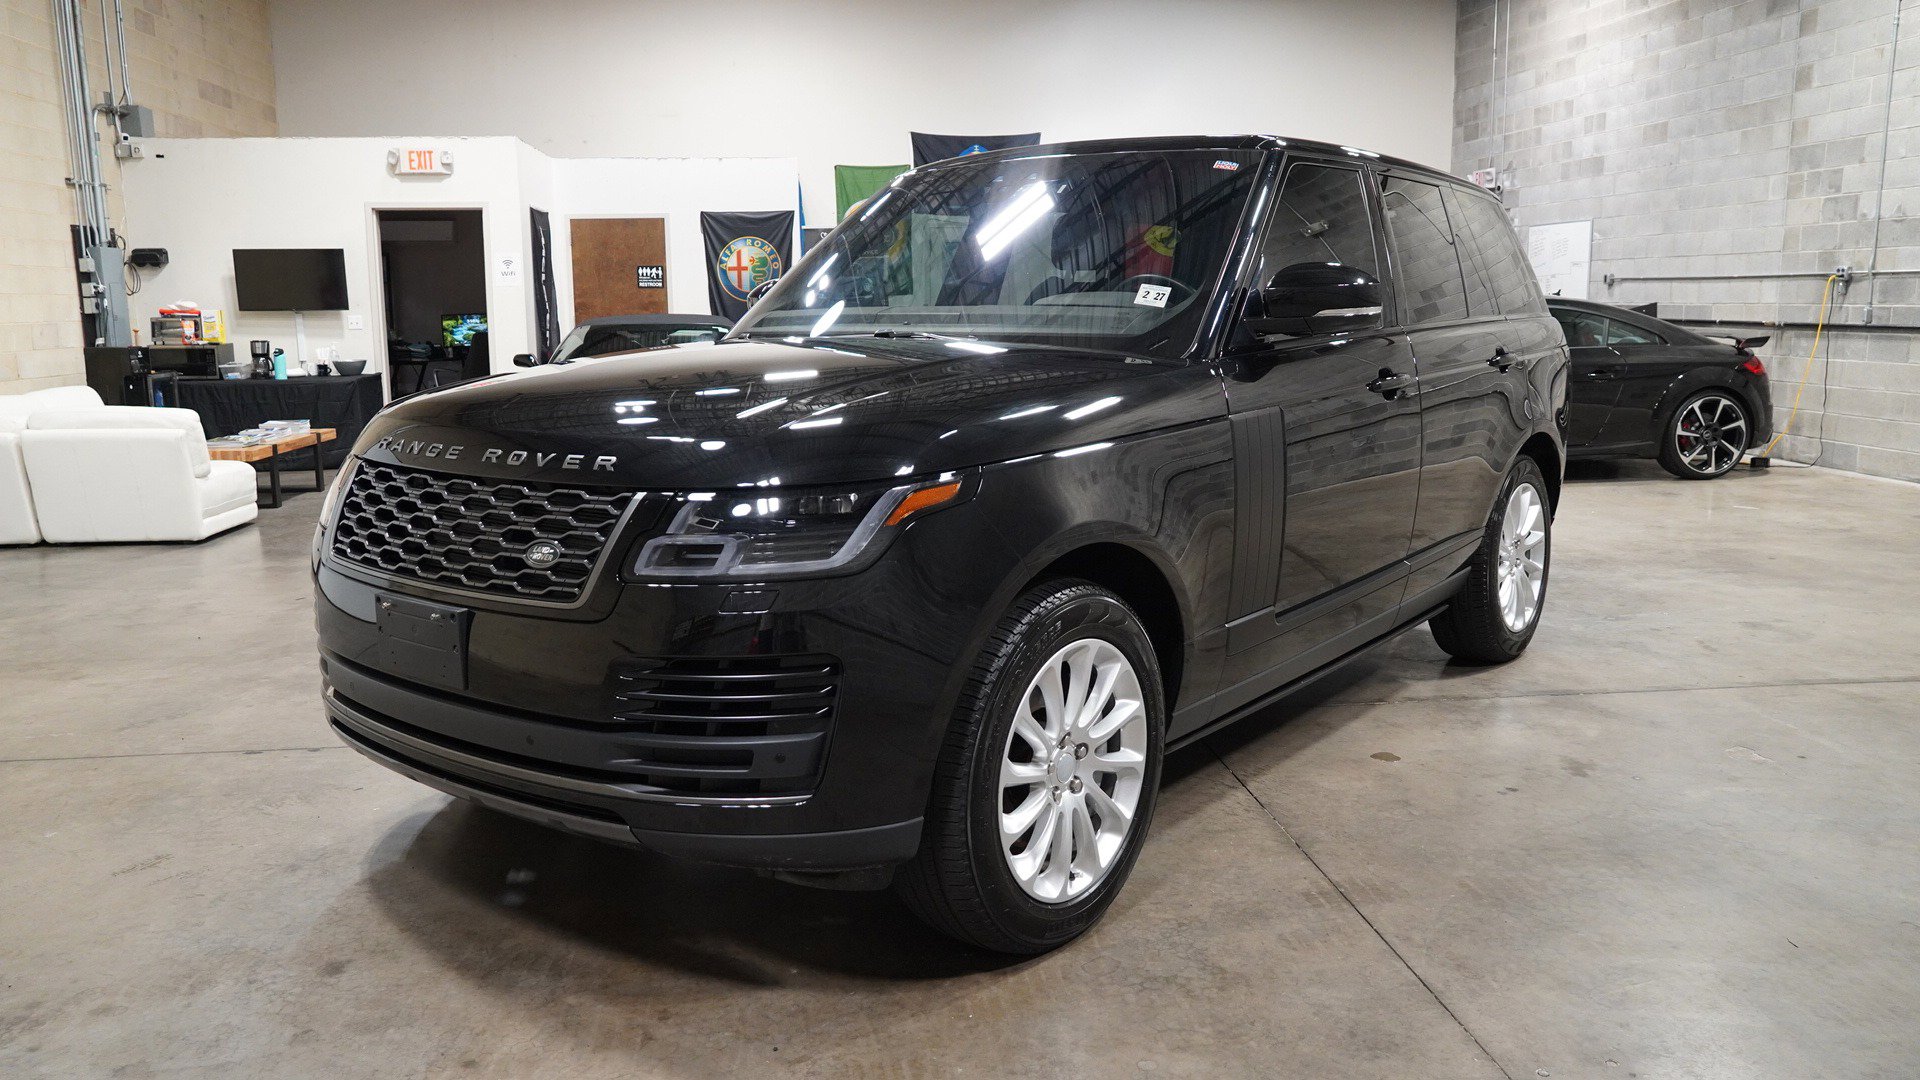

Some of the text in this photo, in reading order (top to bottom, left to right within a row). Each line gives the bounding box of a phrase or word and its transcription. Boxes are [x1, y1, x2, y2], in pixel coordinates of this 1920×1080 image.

[408, 150, 433, 170] EXIT
[720, 239, 780, 270] ALFA ROMEO
[1142, 290, 1167, 301] 2 27
[377, 436, 618, 472] RANGE ROVER
